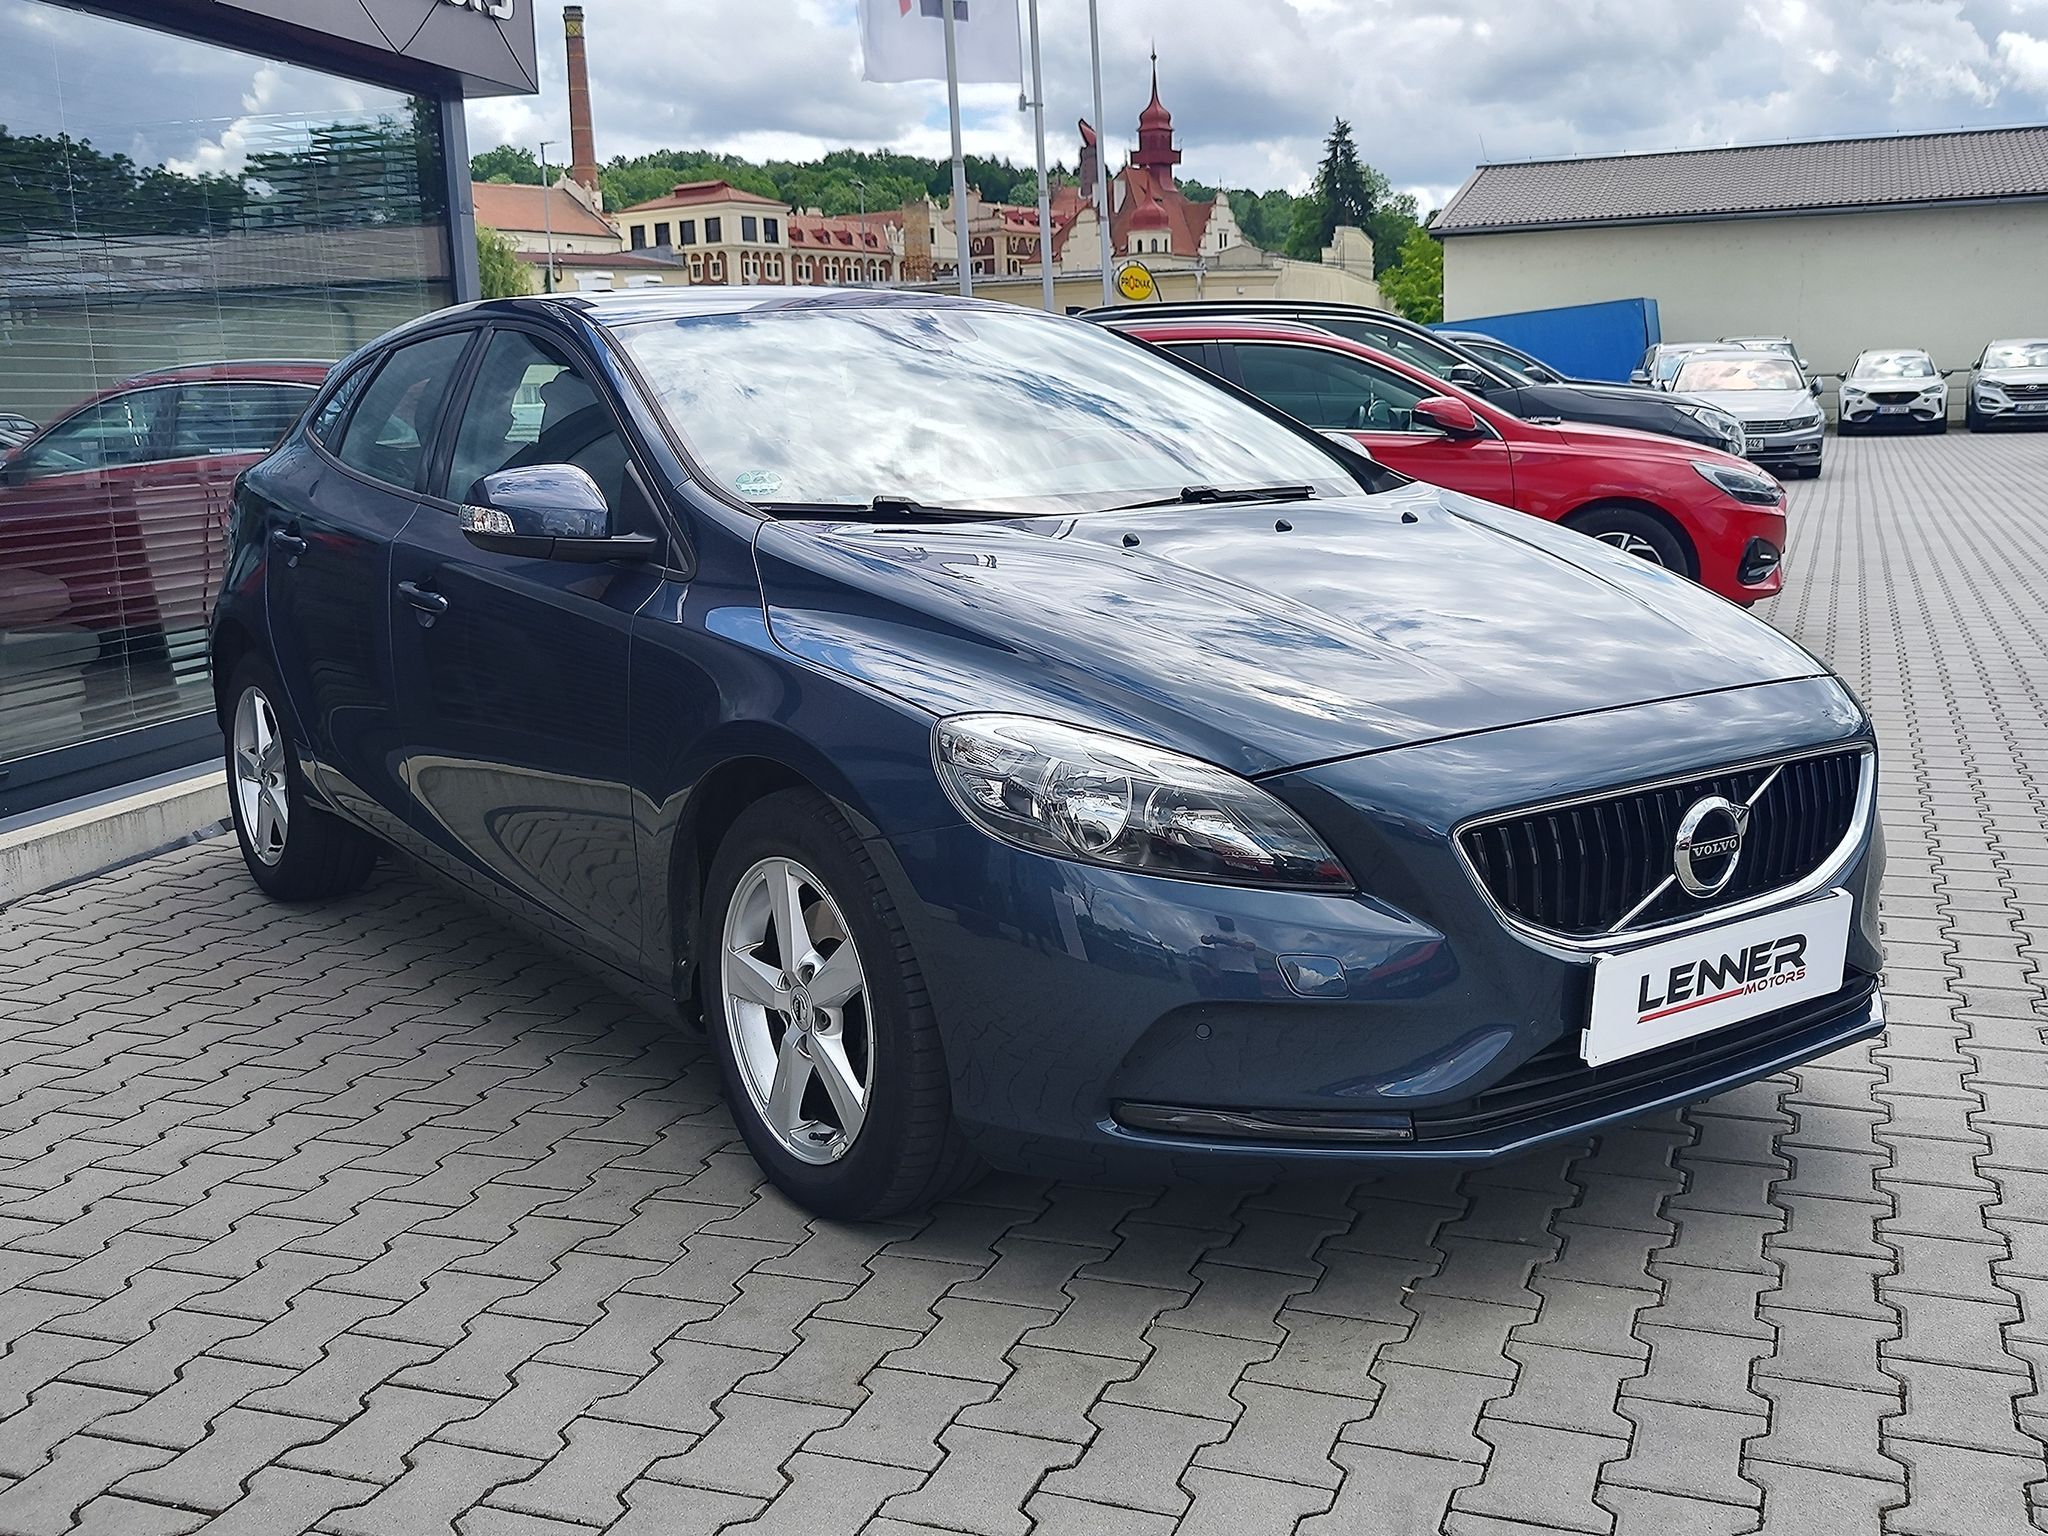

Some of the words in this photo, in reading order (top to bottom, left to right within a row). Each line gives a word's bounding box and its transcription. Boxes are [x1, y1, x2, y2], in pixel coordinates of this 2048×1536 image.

[1692, 839, 1737, 857] VOLVO
[1638, 934, 1807, 1013] LENNER
[1743, 968, 1806, 995] MOTORS
